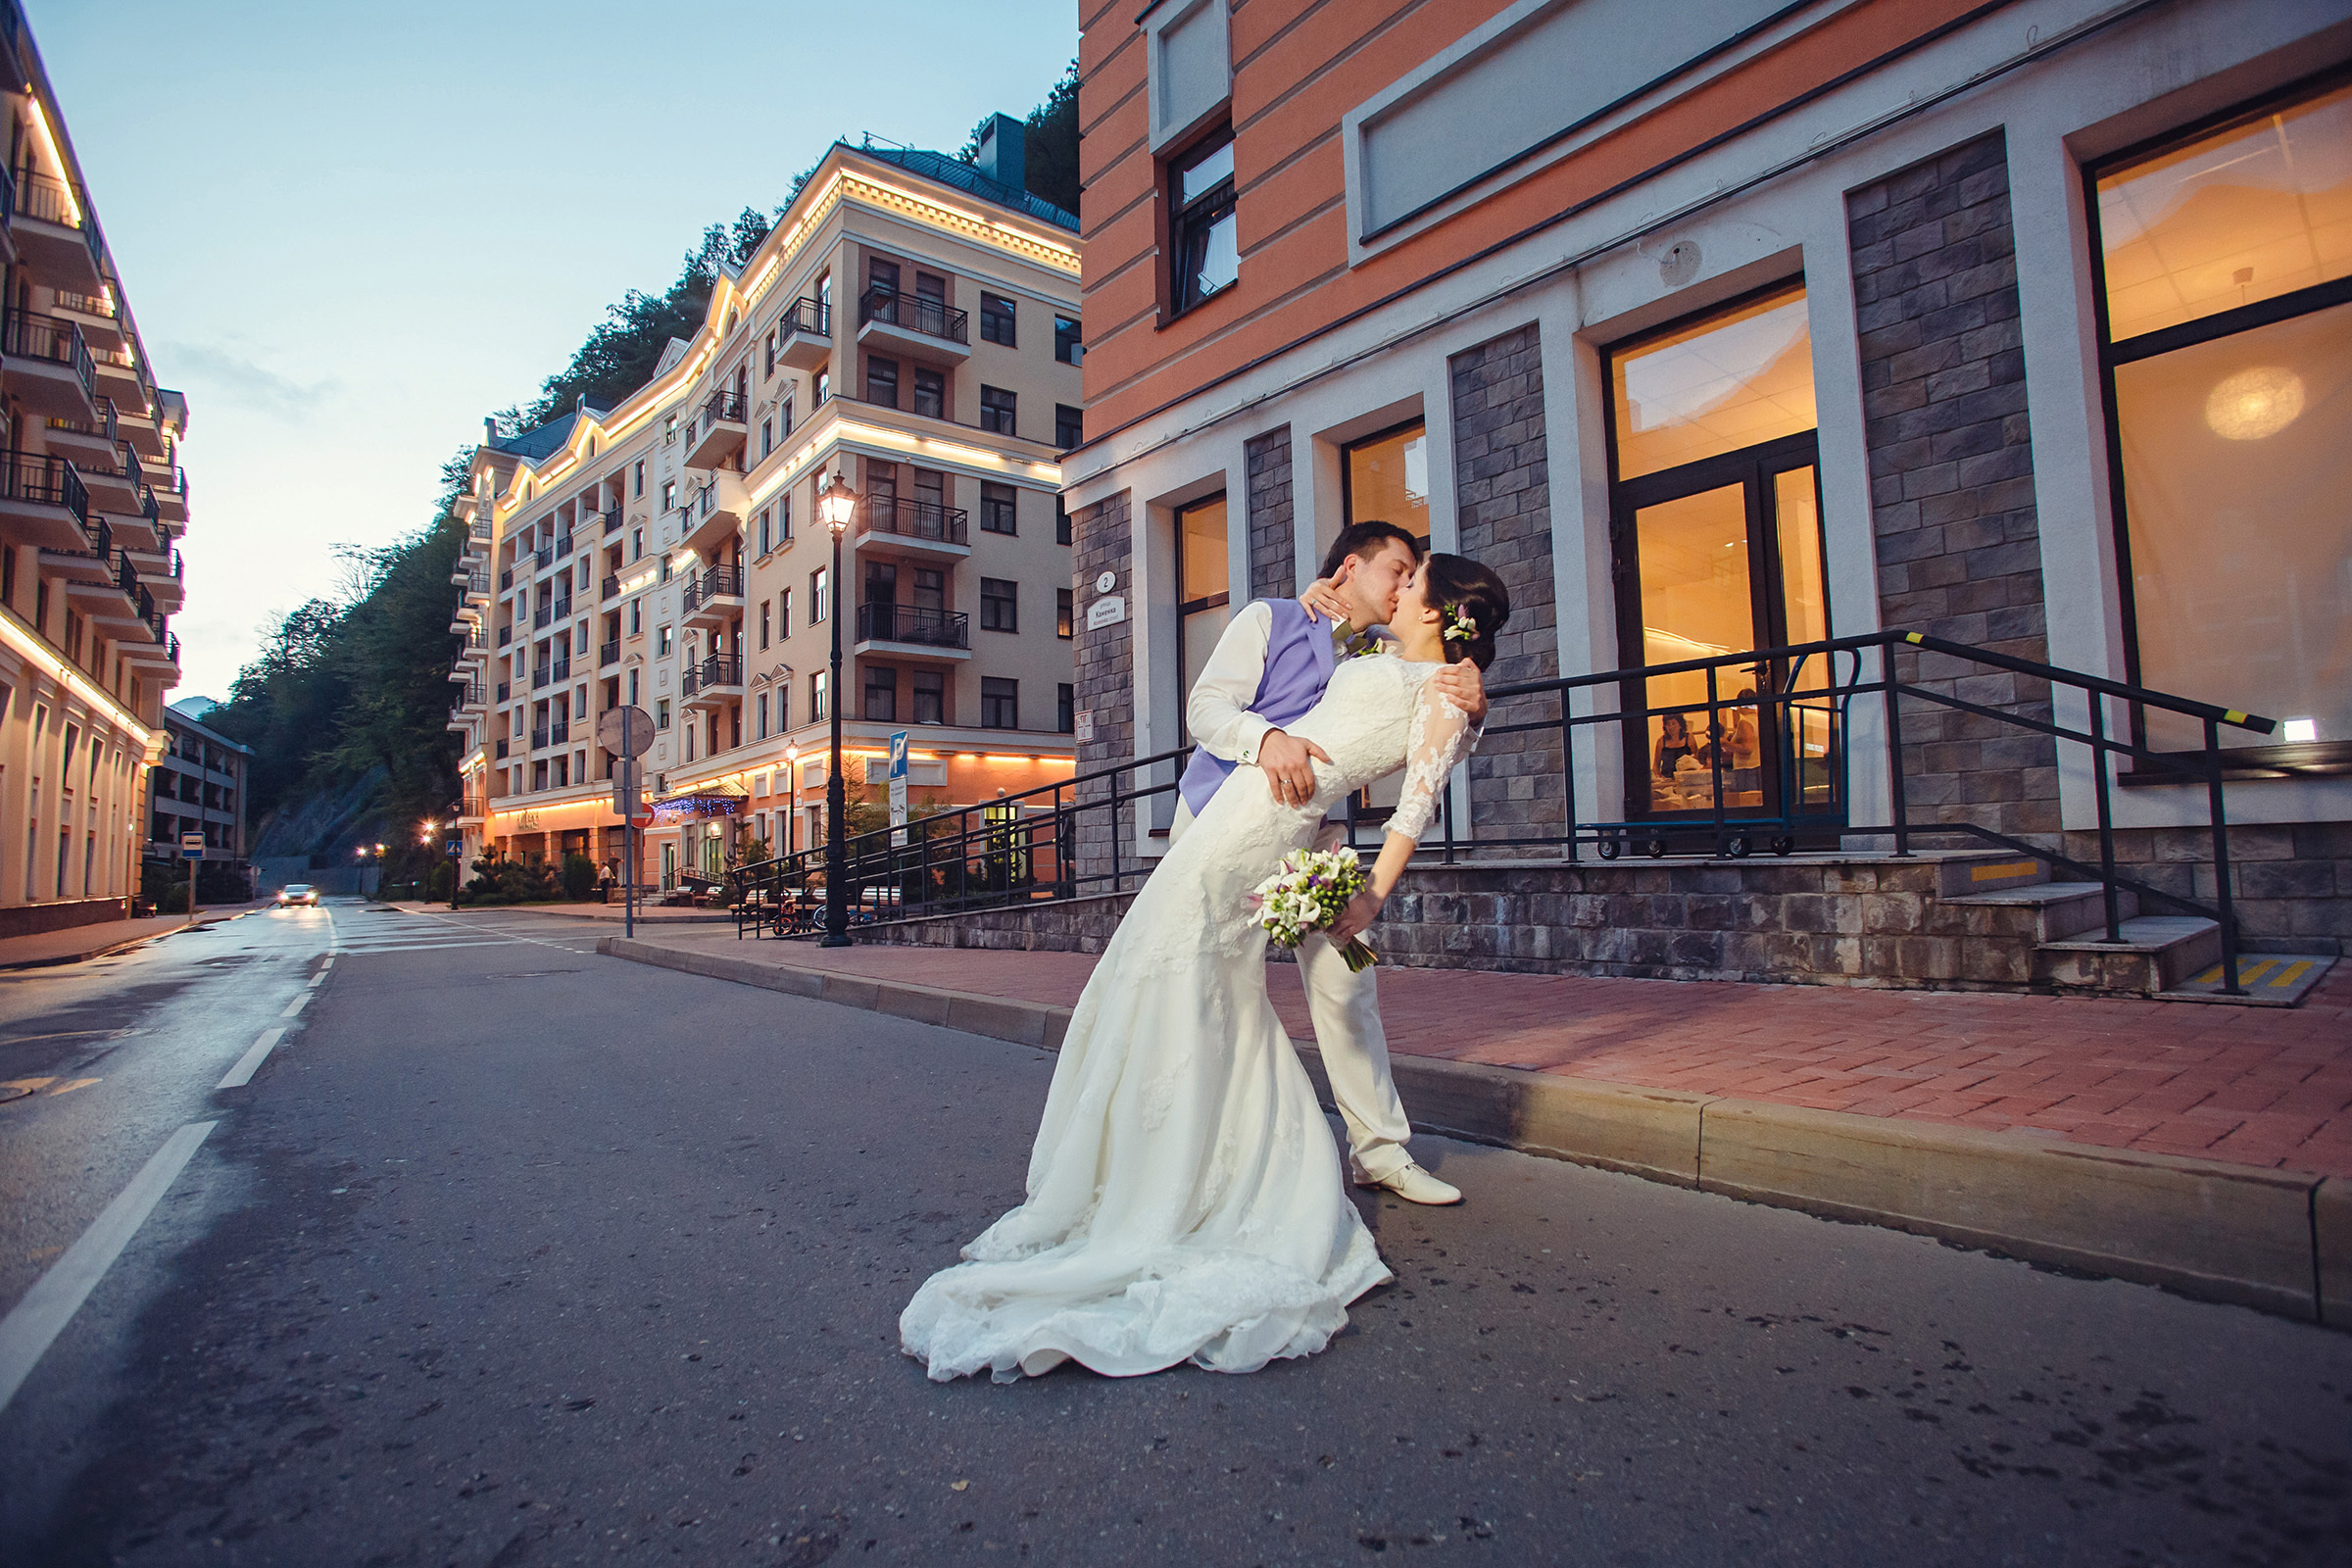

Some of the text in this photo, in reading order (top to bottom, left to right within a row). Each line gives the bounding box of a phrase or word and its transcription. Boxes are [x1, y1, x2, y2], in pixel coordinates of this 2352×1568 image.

[1103, 577, 1108, 588] 2
[1096, 608, 1116, 618] Каменка
[894, 738, 905, 774] P
